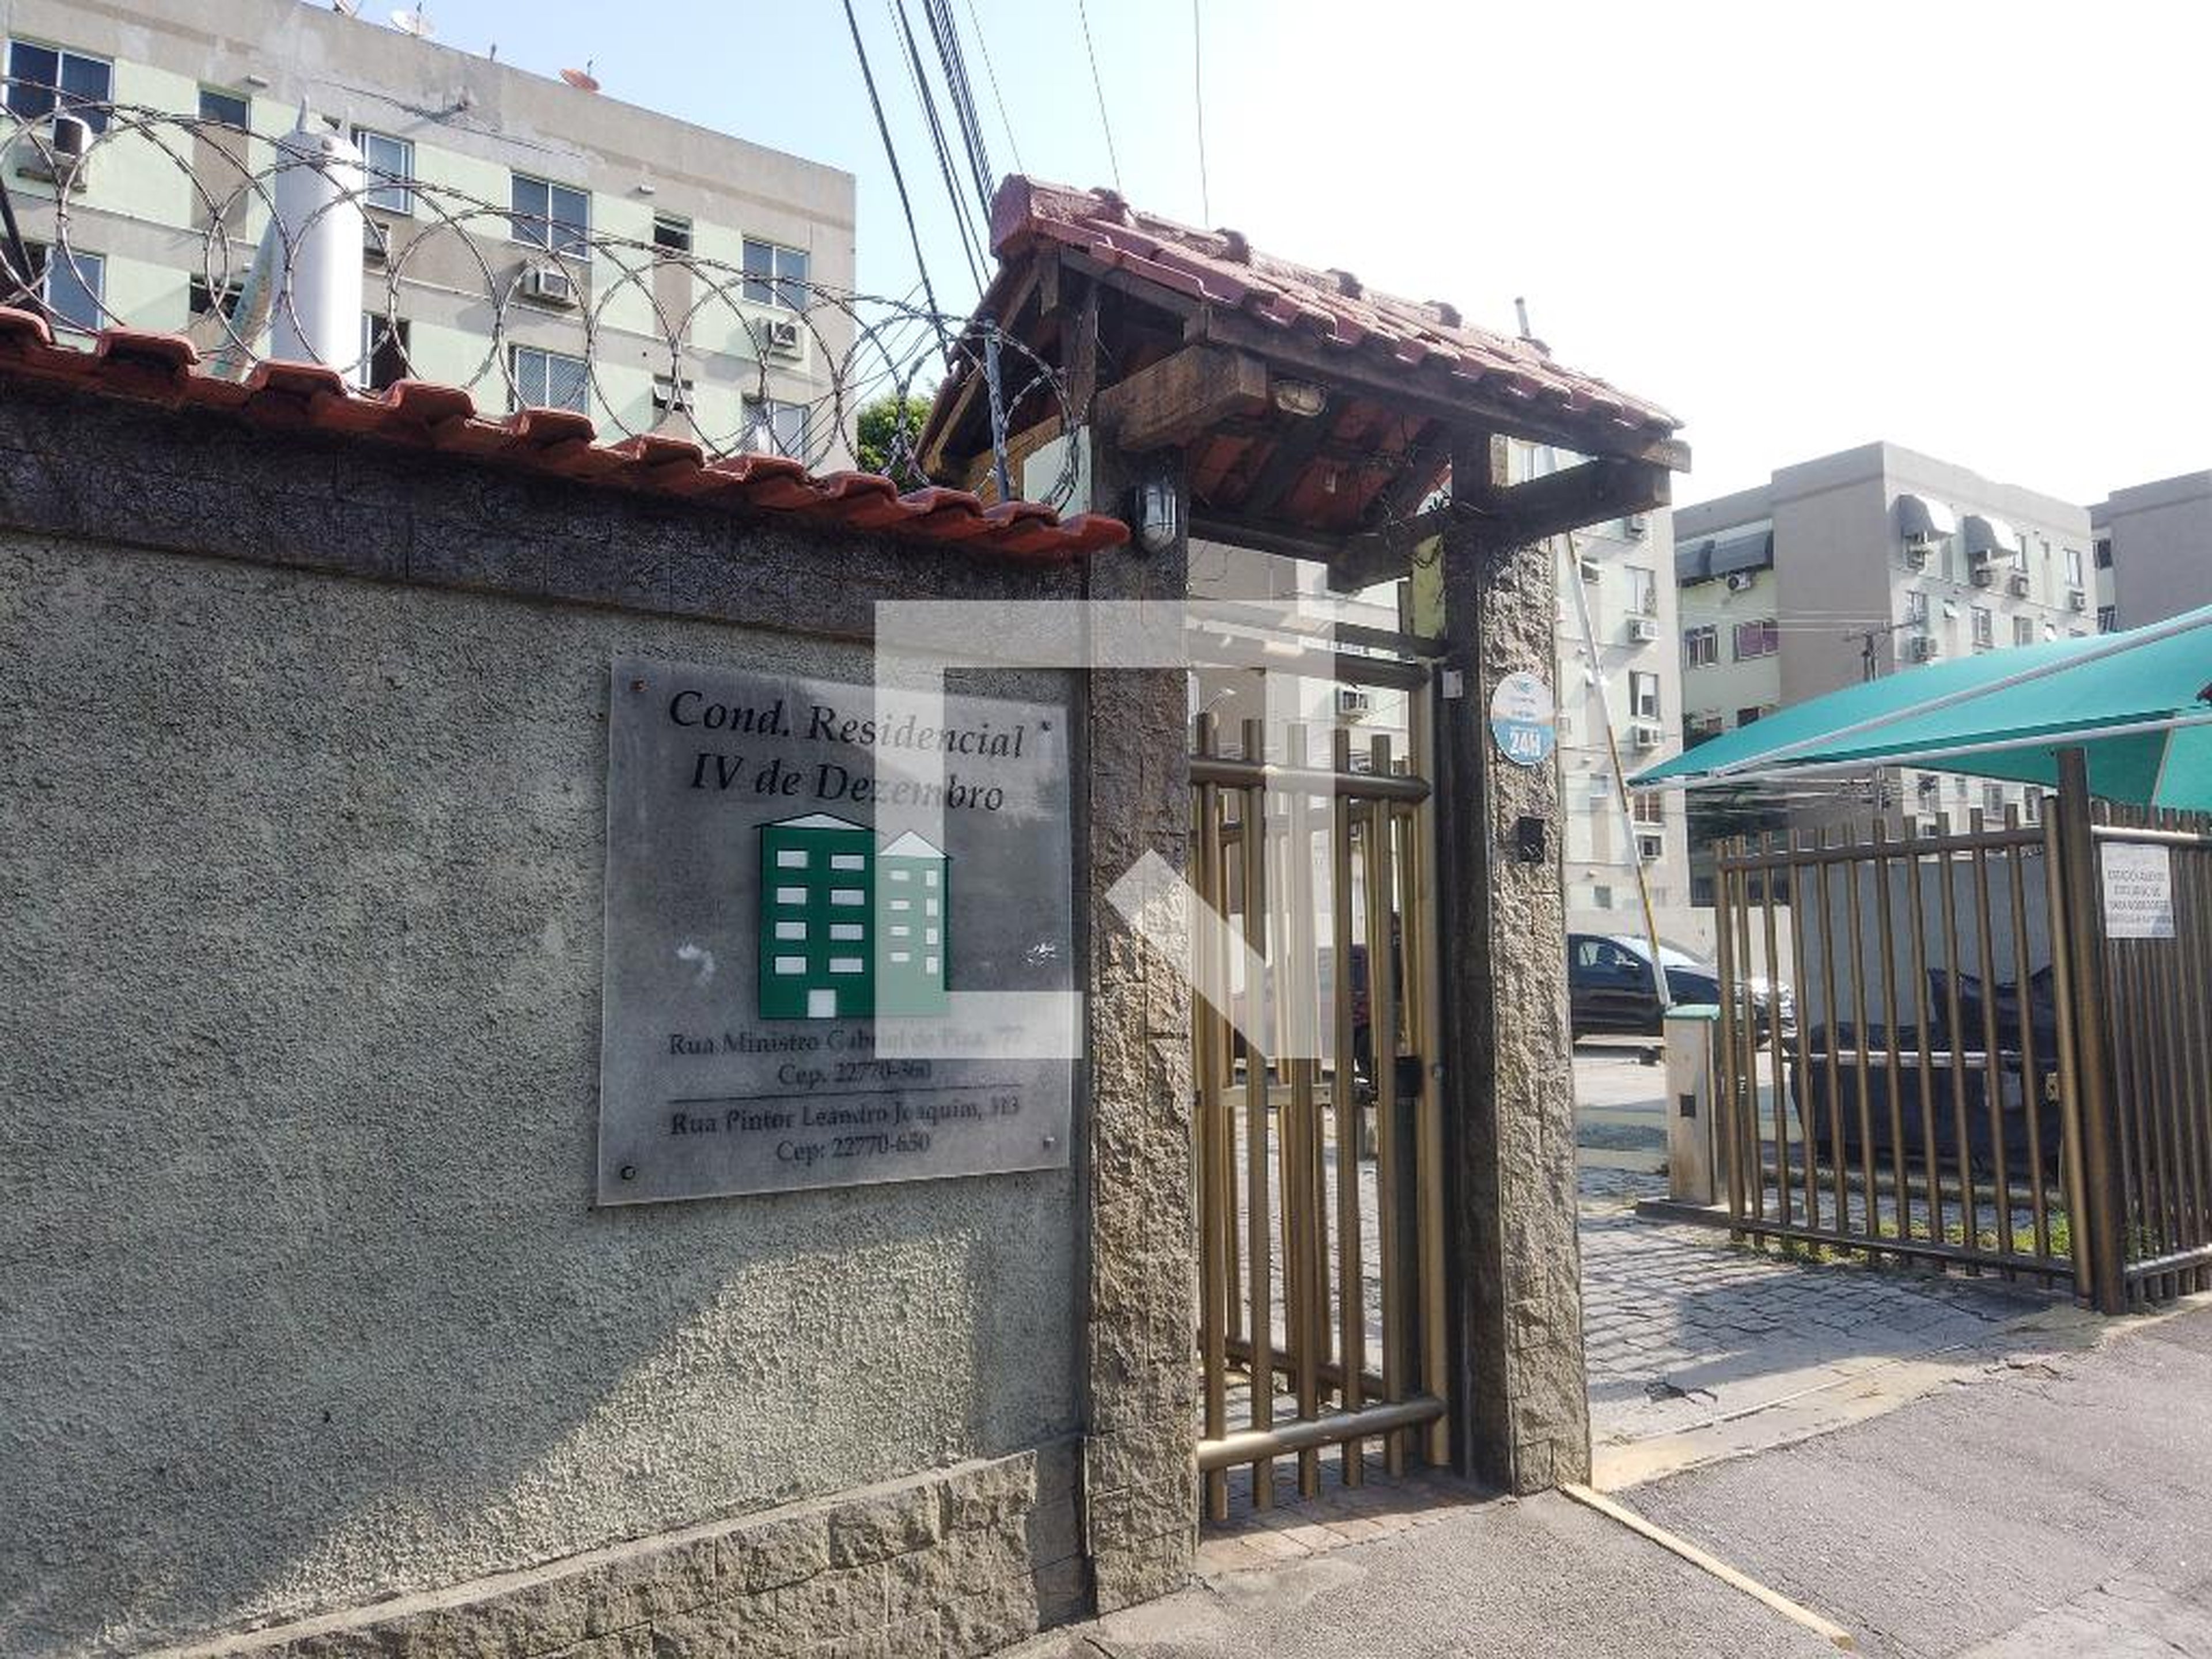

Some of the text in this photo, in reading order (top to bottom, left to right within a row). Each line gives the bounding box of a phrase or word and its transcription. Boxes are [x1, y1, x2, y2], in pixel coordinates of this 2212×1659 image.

[669, 690, 1025, 759] Cond. Residencial
[691, 752, 1004, 812] IV de Dezembro
[669, 1033, 714, 1055] Rua
[671, 1112, 717, 1135] Rua
[802, 1103, 888, 1127] Leandro
